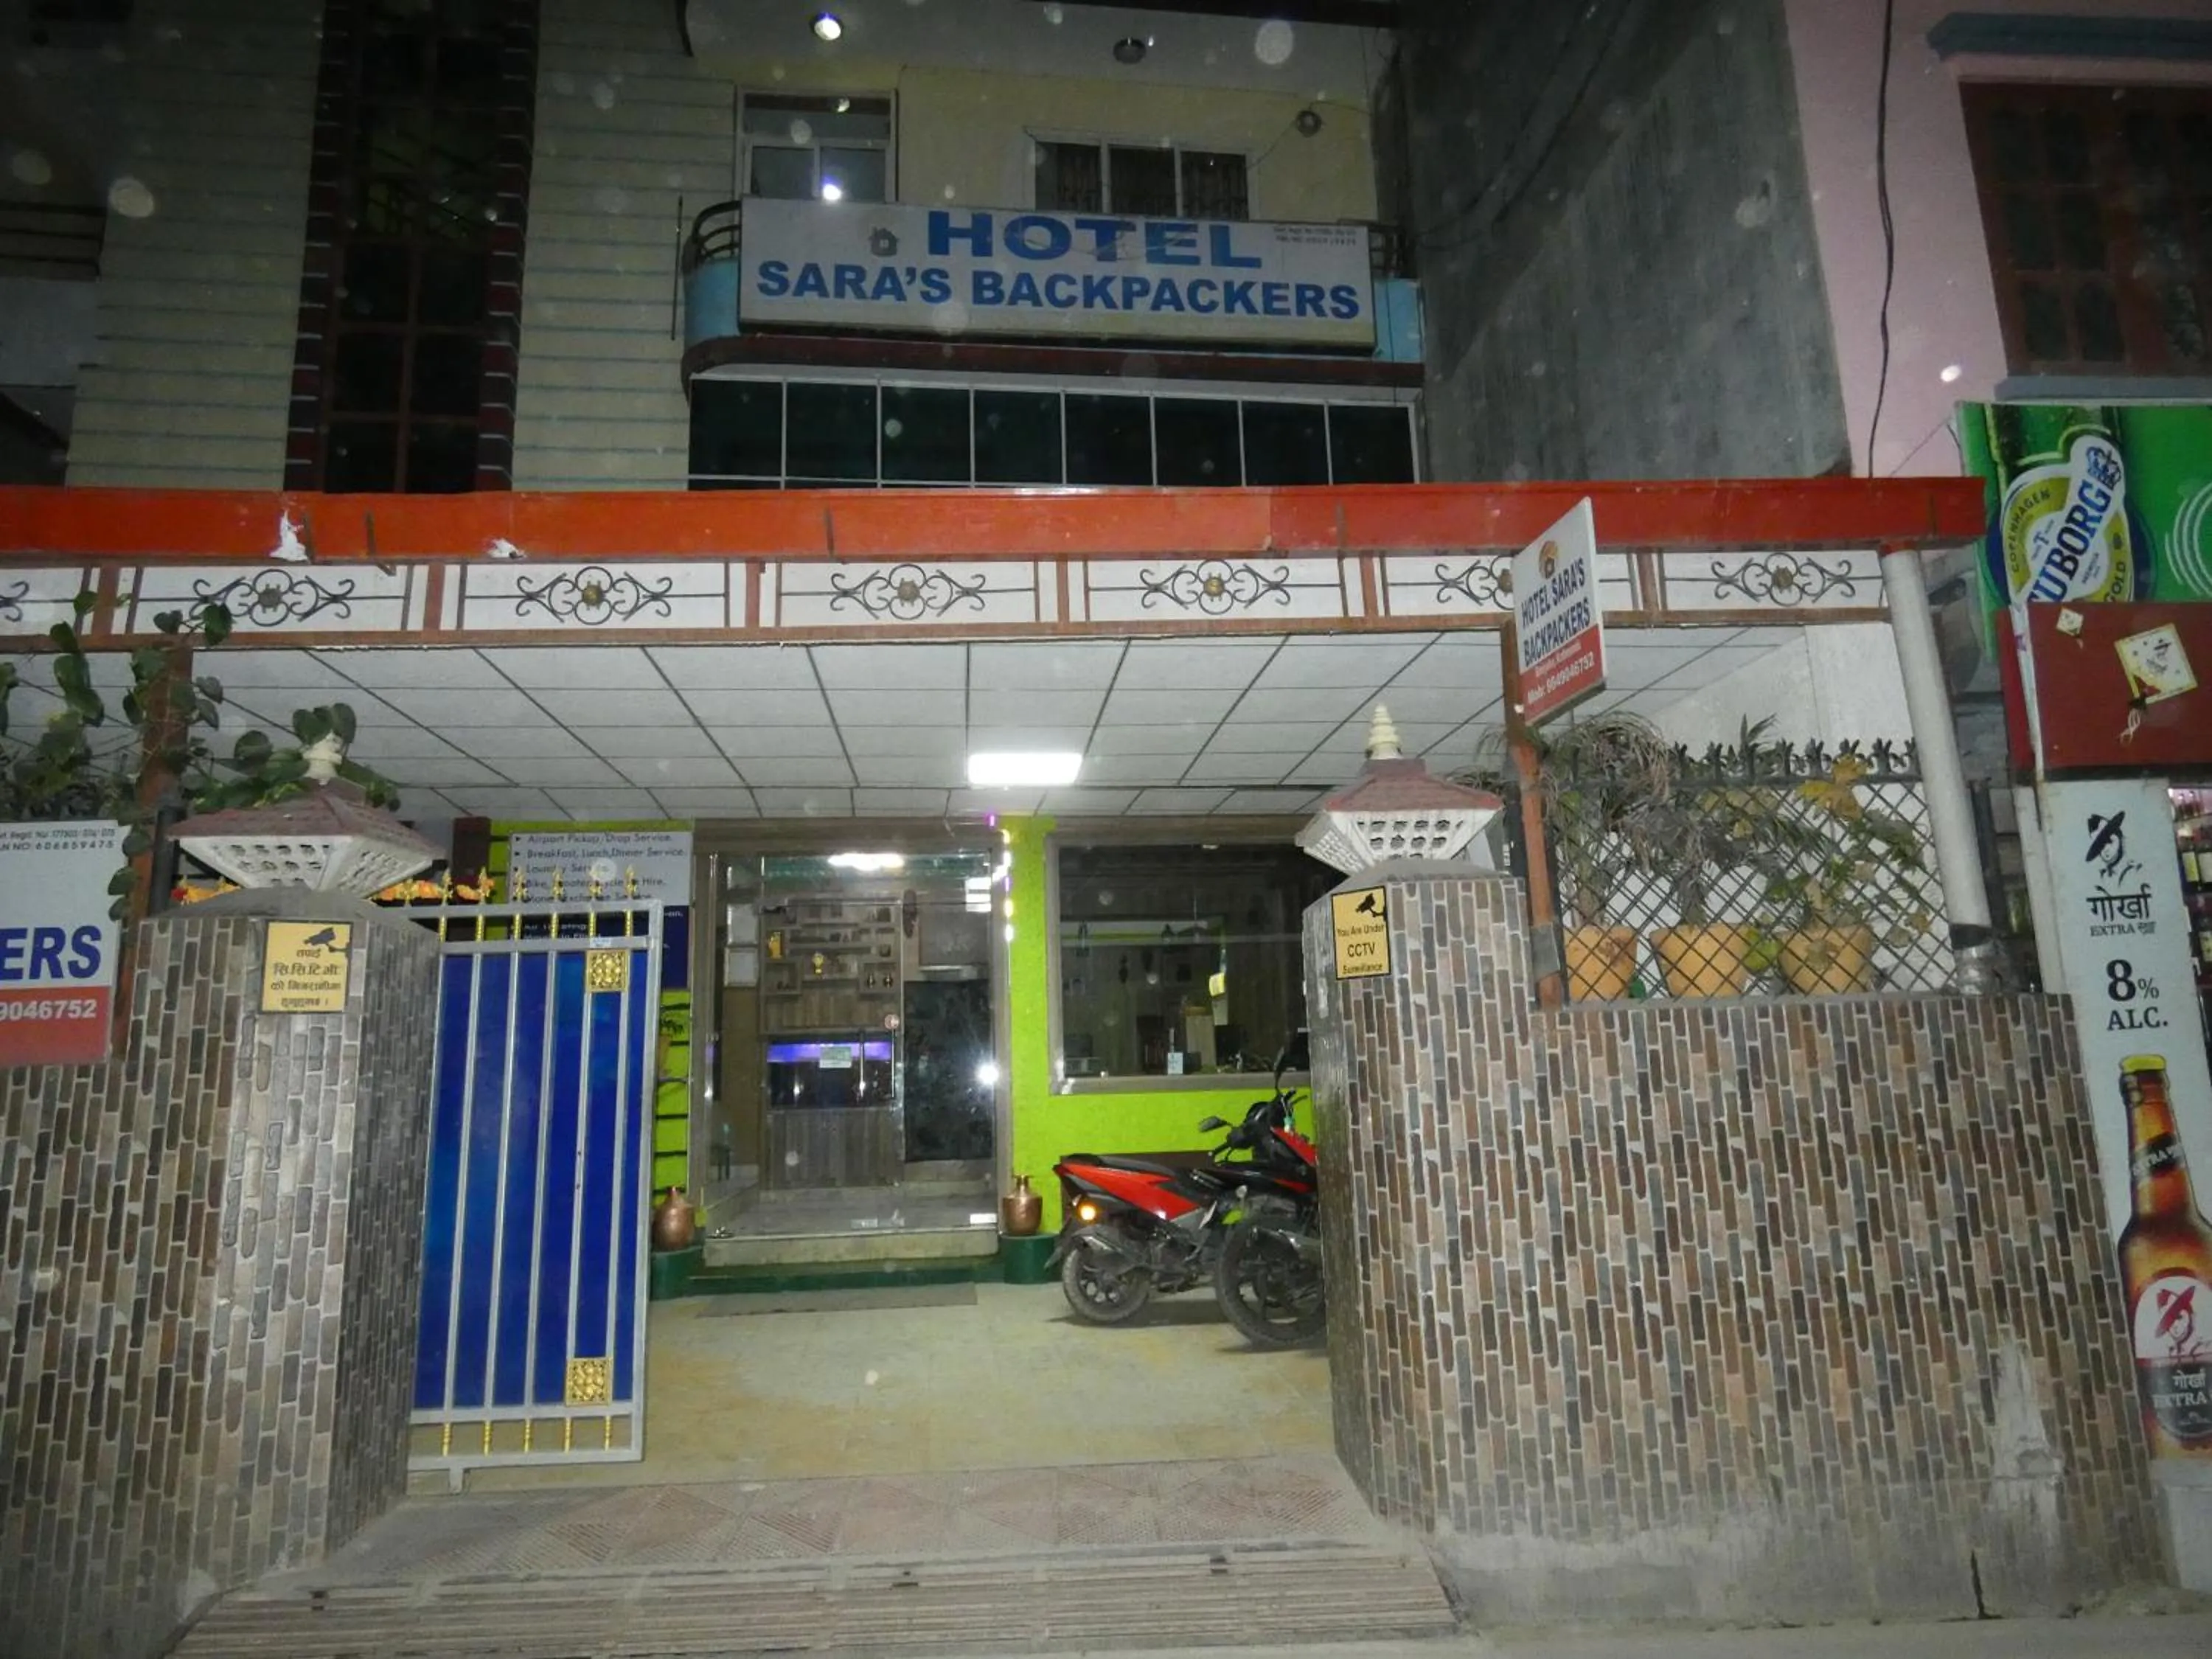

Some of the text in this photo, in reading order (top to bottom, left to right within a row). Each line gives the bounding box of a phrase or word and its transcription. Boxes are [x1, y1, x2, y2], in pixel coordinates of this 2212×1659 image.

[928, 211, 1262, 270] HOTEL
[757, 260, 1360, 320] SARA'S BACKPACKERS
[2028, 479, 2113, 602] UBORG
[1520, 557, 1585, 627] HOTEL SARA'S
[1523, 598, 1591, 667] BACKPACKERS
[528, 835, 564, 845] Airport
[2086, 882, 2152, 922] गोर्खा
[1347, 942, 1376, 958] CCTV
[2090, 922, 2135, 936] EXTRA
[0, 925, 101, 980] ERS
[2106, 959, 2160, 1001] 8%
[2107, 1006, 2168, 1032] ALC.
[2152, 1391, 2208, 1408] EXTRA
